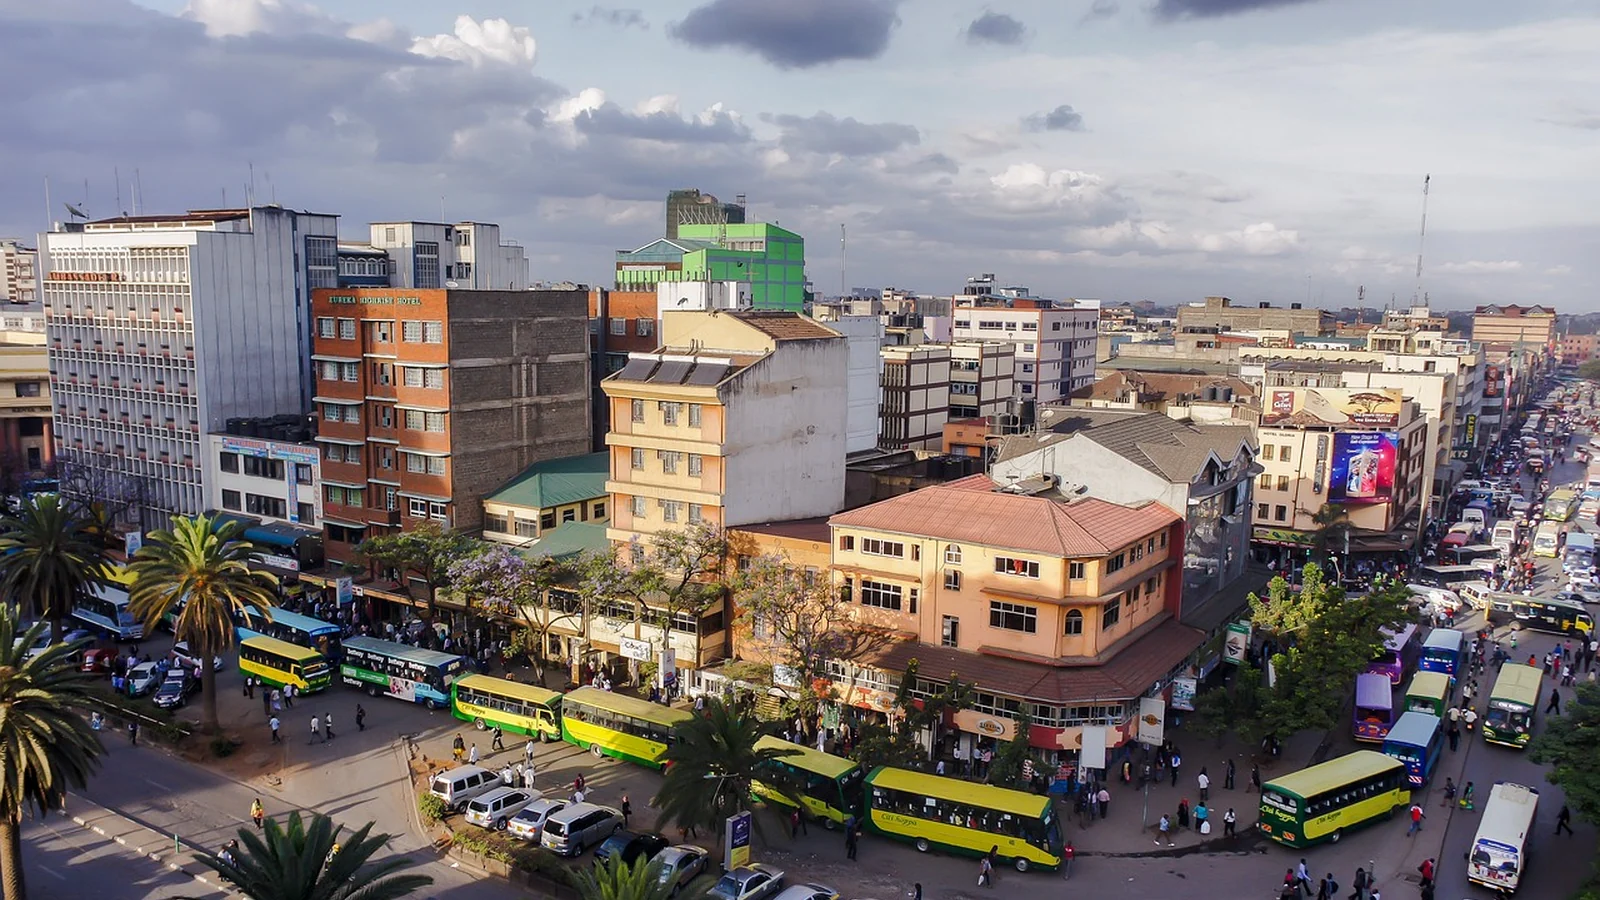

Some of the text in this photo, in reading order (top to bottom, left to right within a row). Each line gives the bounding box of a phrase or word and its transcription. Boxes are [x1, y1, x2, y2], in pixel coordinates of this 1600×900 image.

[328, 296, 356, 304] EUREKA
[397, 297, 421, 305] HOTEL
[1467, 415, 1476, 443] TUSKYS
[1449, 450, 1469, 459] KYS
[347, 648, 364, 658] betway
[367, 653, 384, 663] betway
[388, 657, 405, 668] betway
[408, 661, 427, 672] betway
[343, 677, 363, 687] betway
